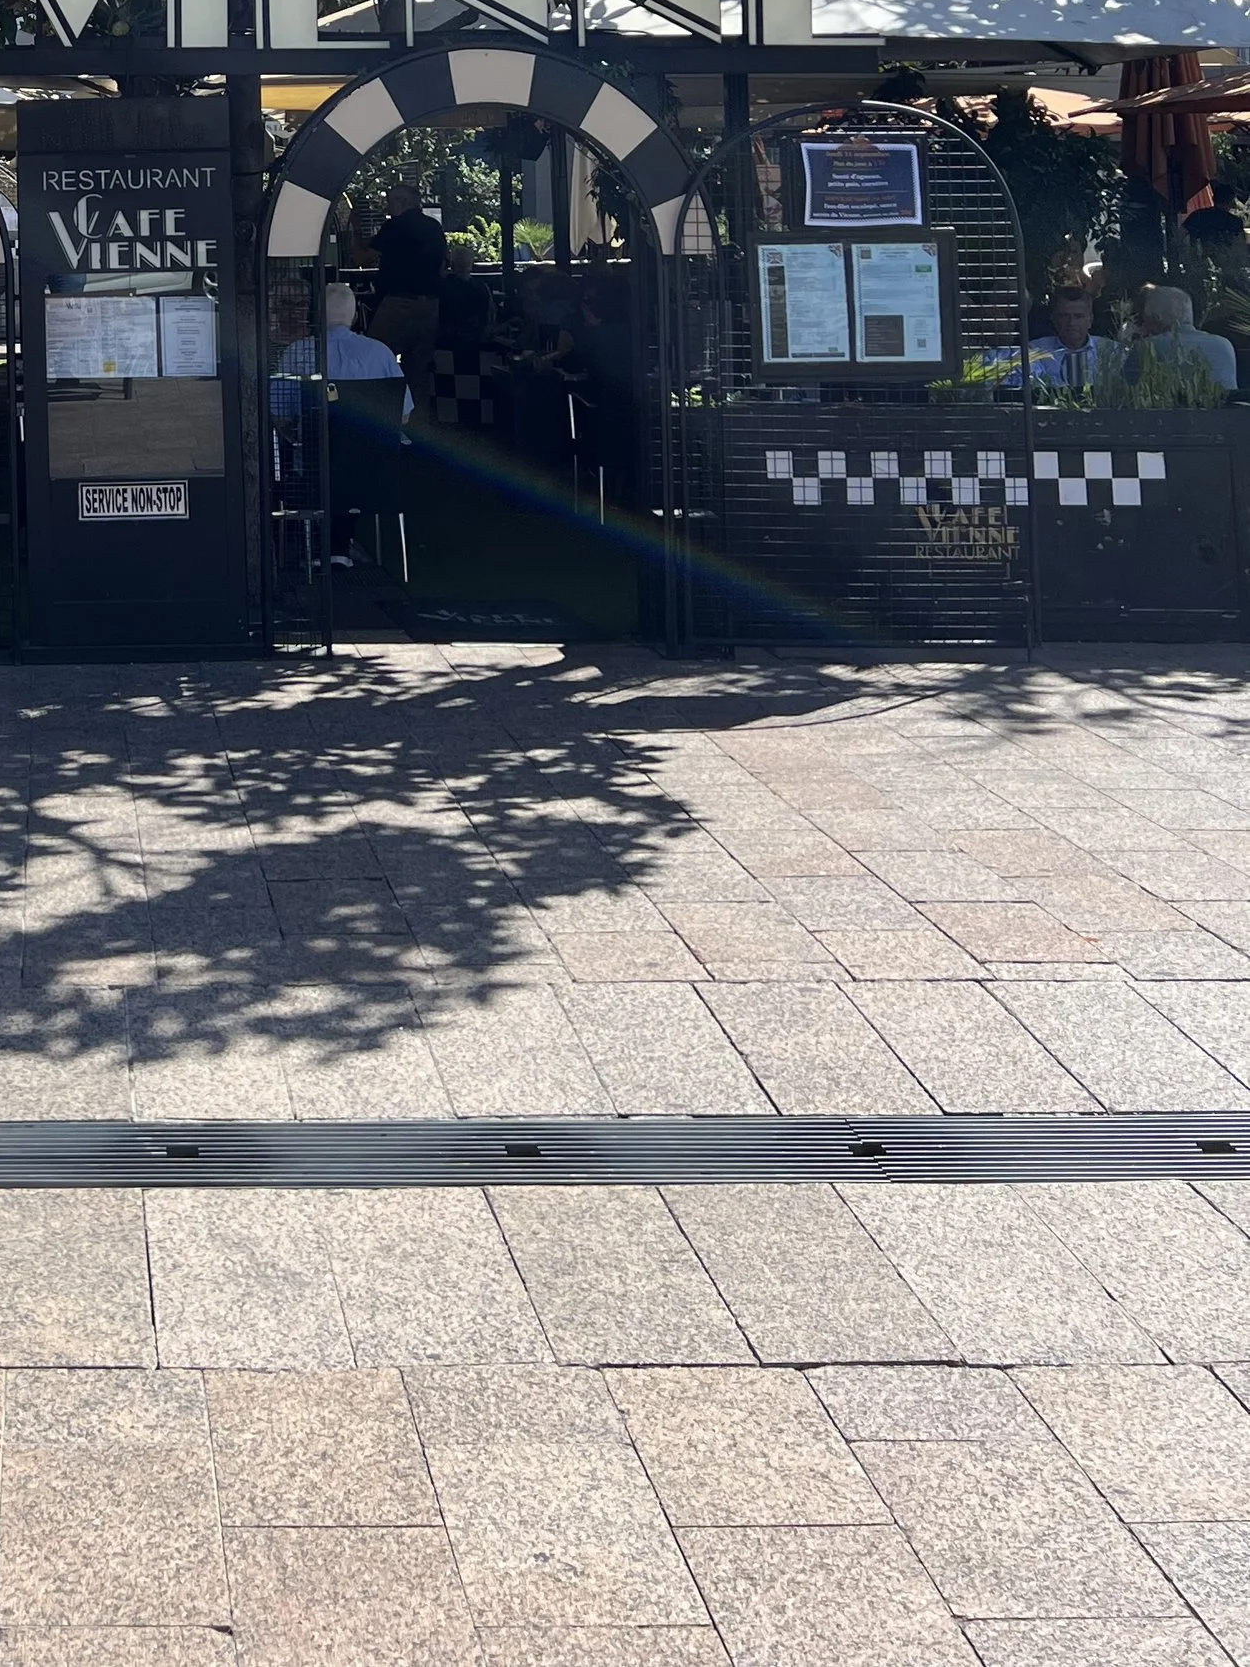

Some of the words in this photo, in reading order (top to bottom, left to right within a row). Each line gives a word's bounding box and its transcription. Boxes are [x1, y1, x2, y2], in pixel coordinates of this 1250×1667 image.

[42, 167, 217, 191] RESTAURANT
[73, 193, 186, 240] CAFE
[46, 210, 218, 270] VIENNE
[85, 487, 129, 514] SERVICE
[131, 485, 183, 513] NON-STOP
[915, 545, 1021, 560] RESTAURANT
